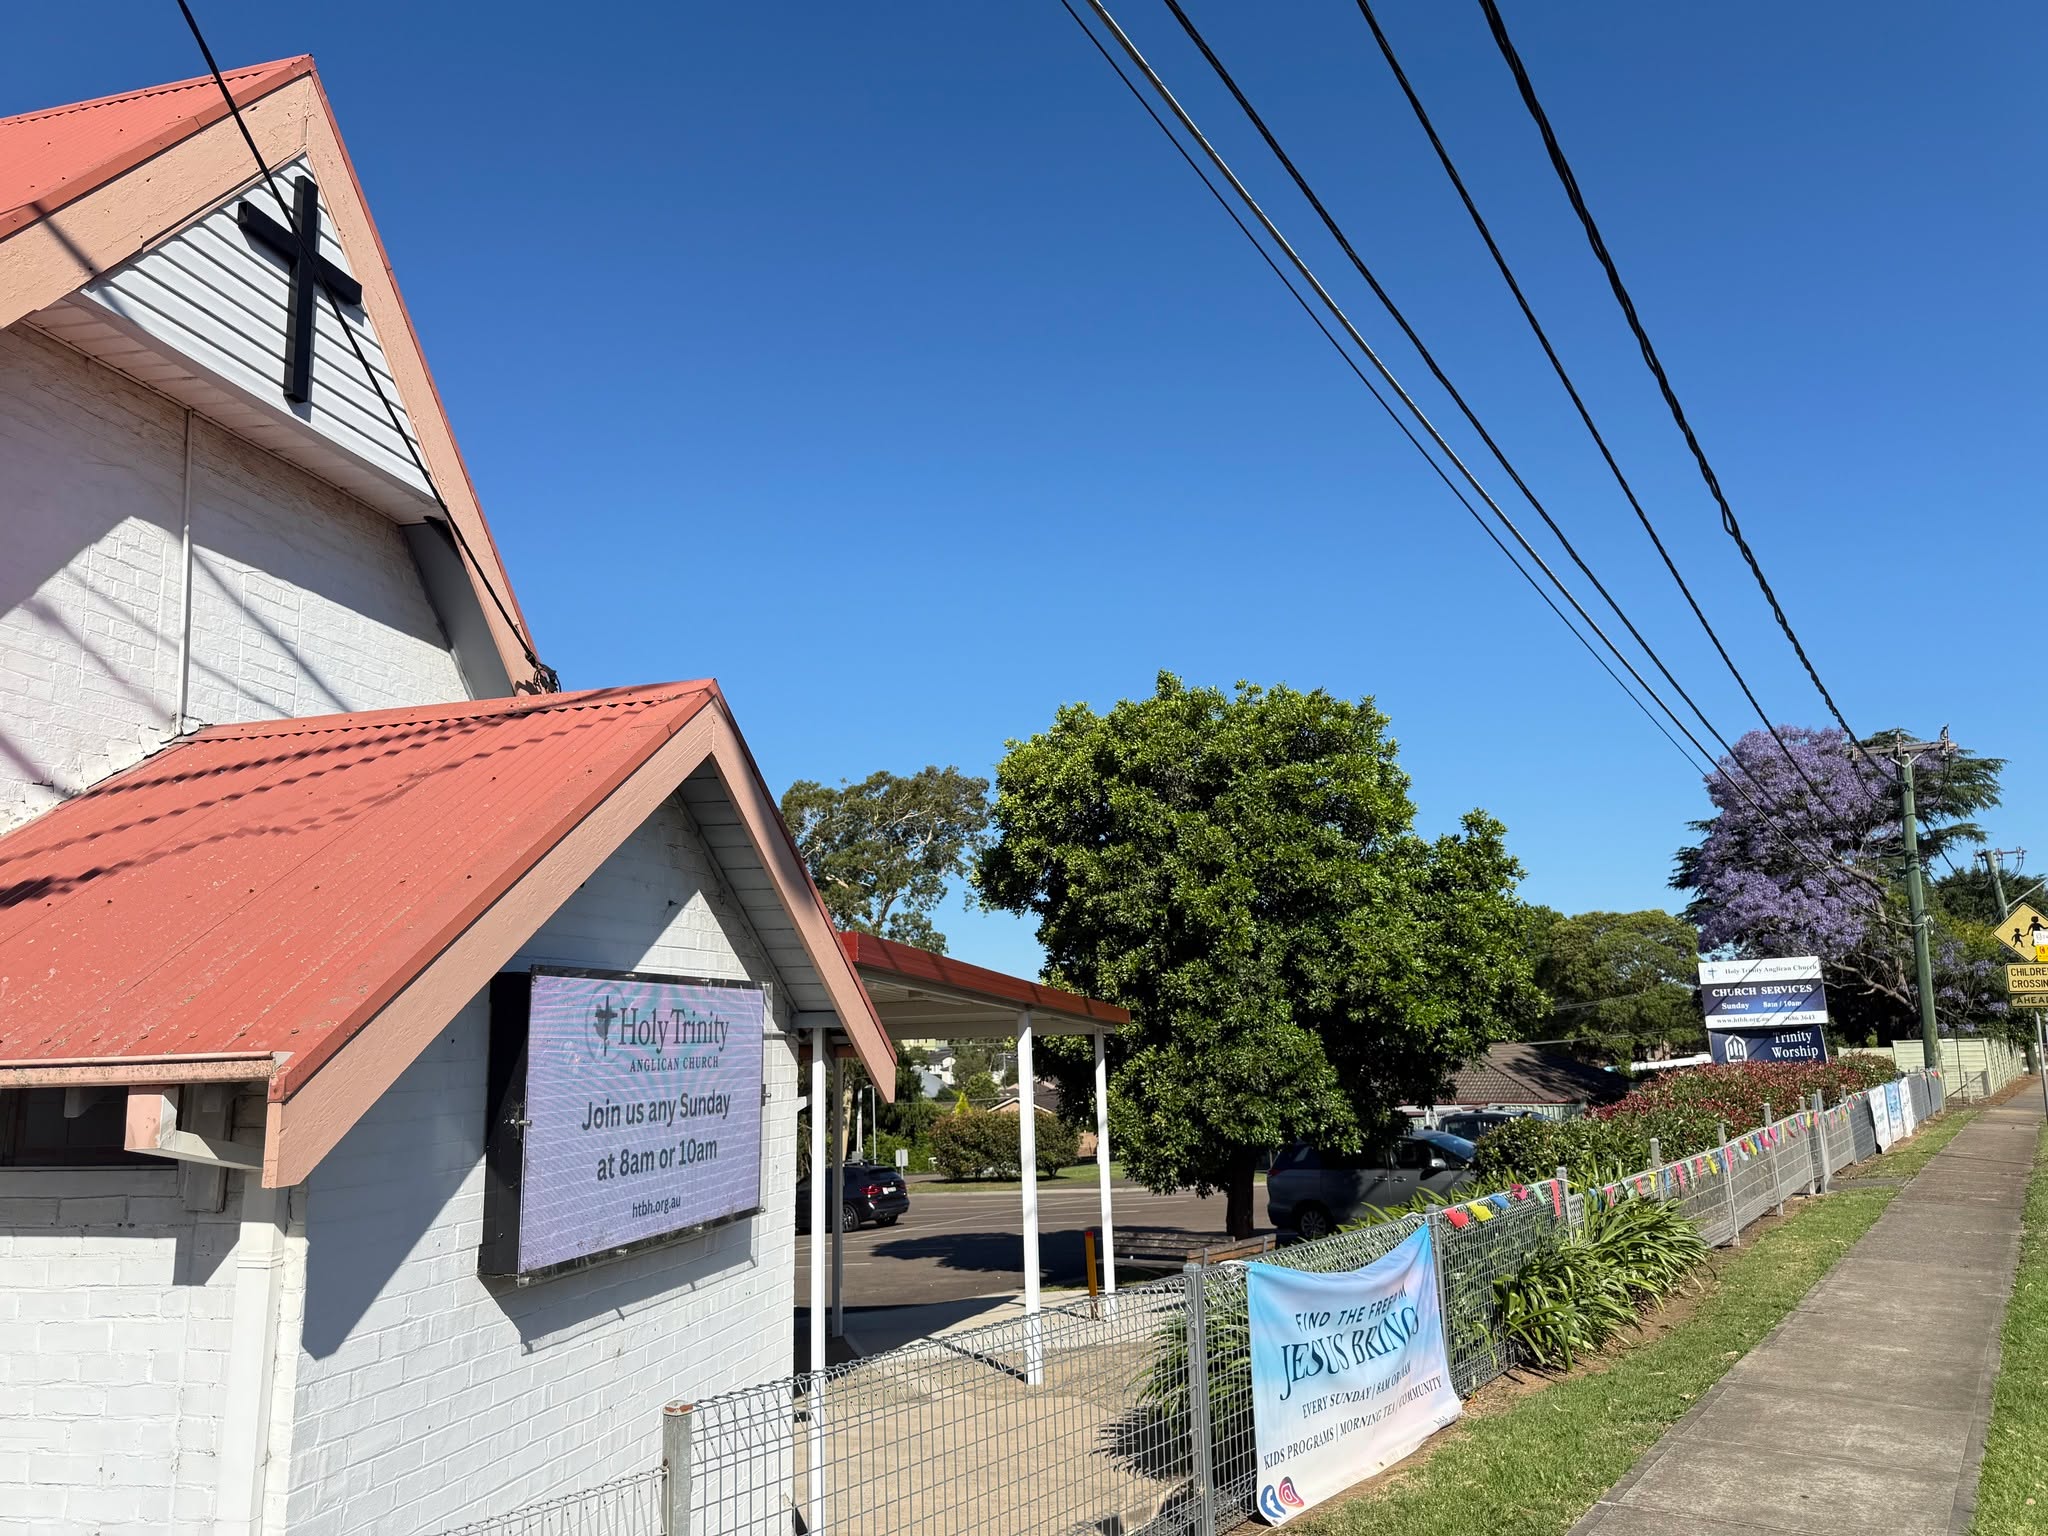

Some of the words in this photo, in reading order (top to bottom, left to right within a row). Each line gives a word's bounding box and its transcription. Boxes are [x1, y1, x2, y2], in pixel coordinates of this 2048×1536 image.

[1764, 965, 1792, 973] Anglican
[1792, 963, 1817, 972] Church
[2010, 967, 2048, 977] CHILDRE
[1712, 987, 1757, 997] CHURCH
[1761, 984, 1813, 995] SERVICES
[1721, 1002, 1749, 1011] Sunday
[1763, 1001, 1778, 1009] 8am
[1784, 1000, 1802, 1008] 10am
[618, 1007, 669, 1054] Holy
[670, 1008, 729, 1052] Trinity
[1773, 1031, 1812, 1044] Trinity
[630, 1057, 680, 1073] ANGLICAN
[683, 1055, 719, 1070] CHURCH
[1771, 1045, 1819, 1059] Worship
[581, 1098, 621, 1131] Join
[625, 1102, 644, 1125] us
[648, 1100, 677, 1128] any
[680, 1089, 731, 1120] Sunday
[597, 1154, 615, 1181] at
[620, 1148, 655, 1175] 8am
[659, 1146, 676, 1170] or
[678, 1138, 718, 1166] 10am
[632, 1194, 681, 1219] htbh.org.au
[1295, 1311, 1331, 1332] FIND
[1337, 1306, 1366, 1326] THE
[1280, 1333, 1350, 1401] JESUS
[1302, 1399, 1328, 1419] EVERY
[1329, 1389, 1372, 1407] SUNDAY
[1263, 1448, 1285, 1470] KIDS
[1287, 1427, 1334, 1460] PROGRAMS
[1339, 1410, 1382, 1437] MORNING
[1398, 1376, 1442, 1409] COMMUNITY
